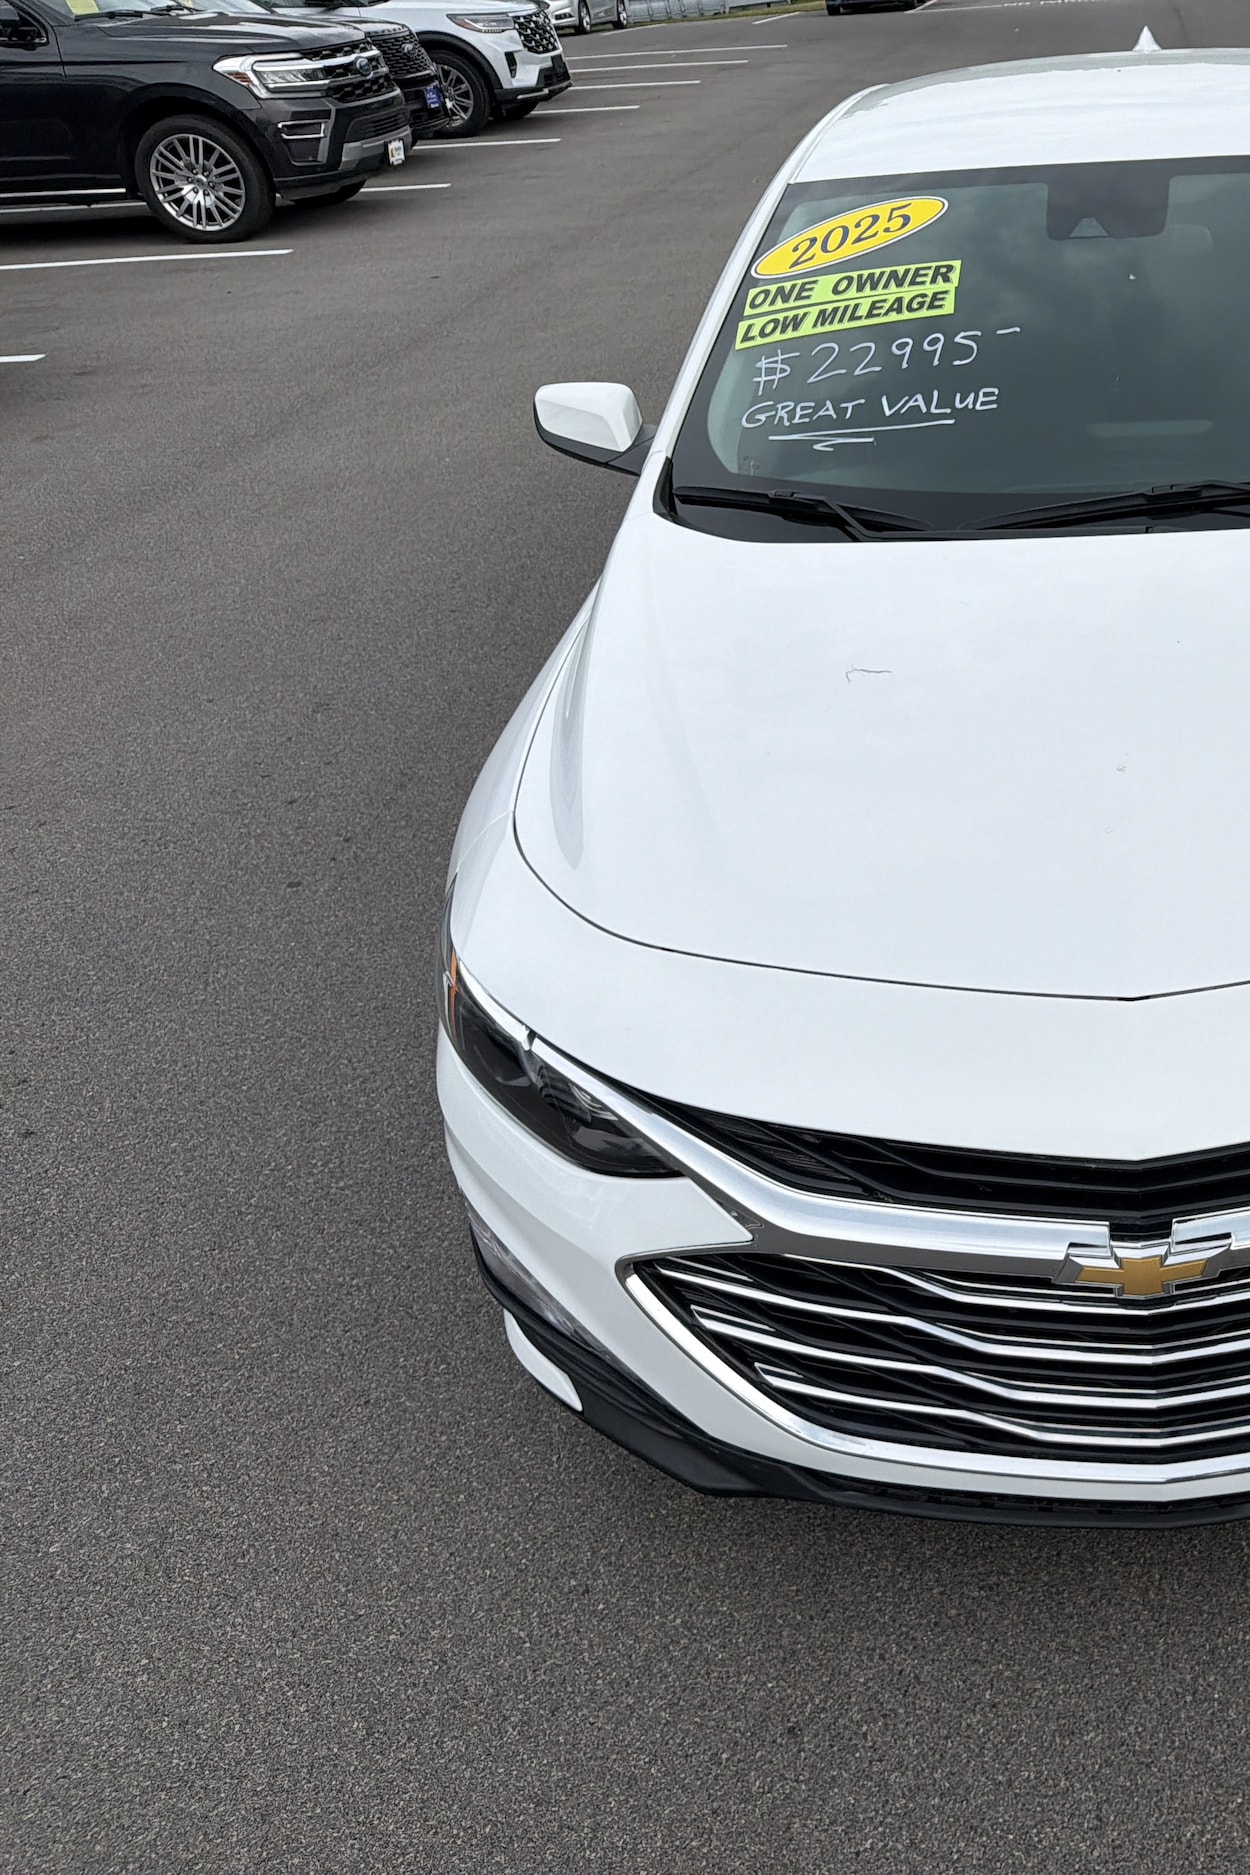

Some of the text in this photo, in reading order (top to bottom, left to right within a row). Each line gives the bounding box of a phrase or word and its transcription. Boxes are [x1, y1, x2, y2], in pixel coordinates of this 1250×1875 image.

[789, 203, 913, 269] 2025
[749, 264, 954, 310] ONE OWNER
[739, 290, 950, 344] LOW MILEAGE
[741, 387, 999, 429] GREAT VALUE
